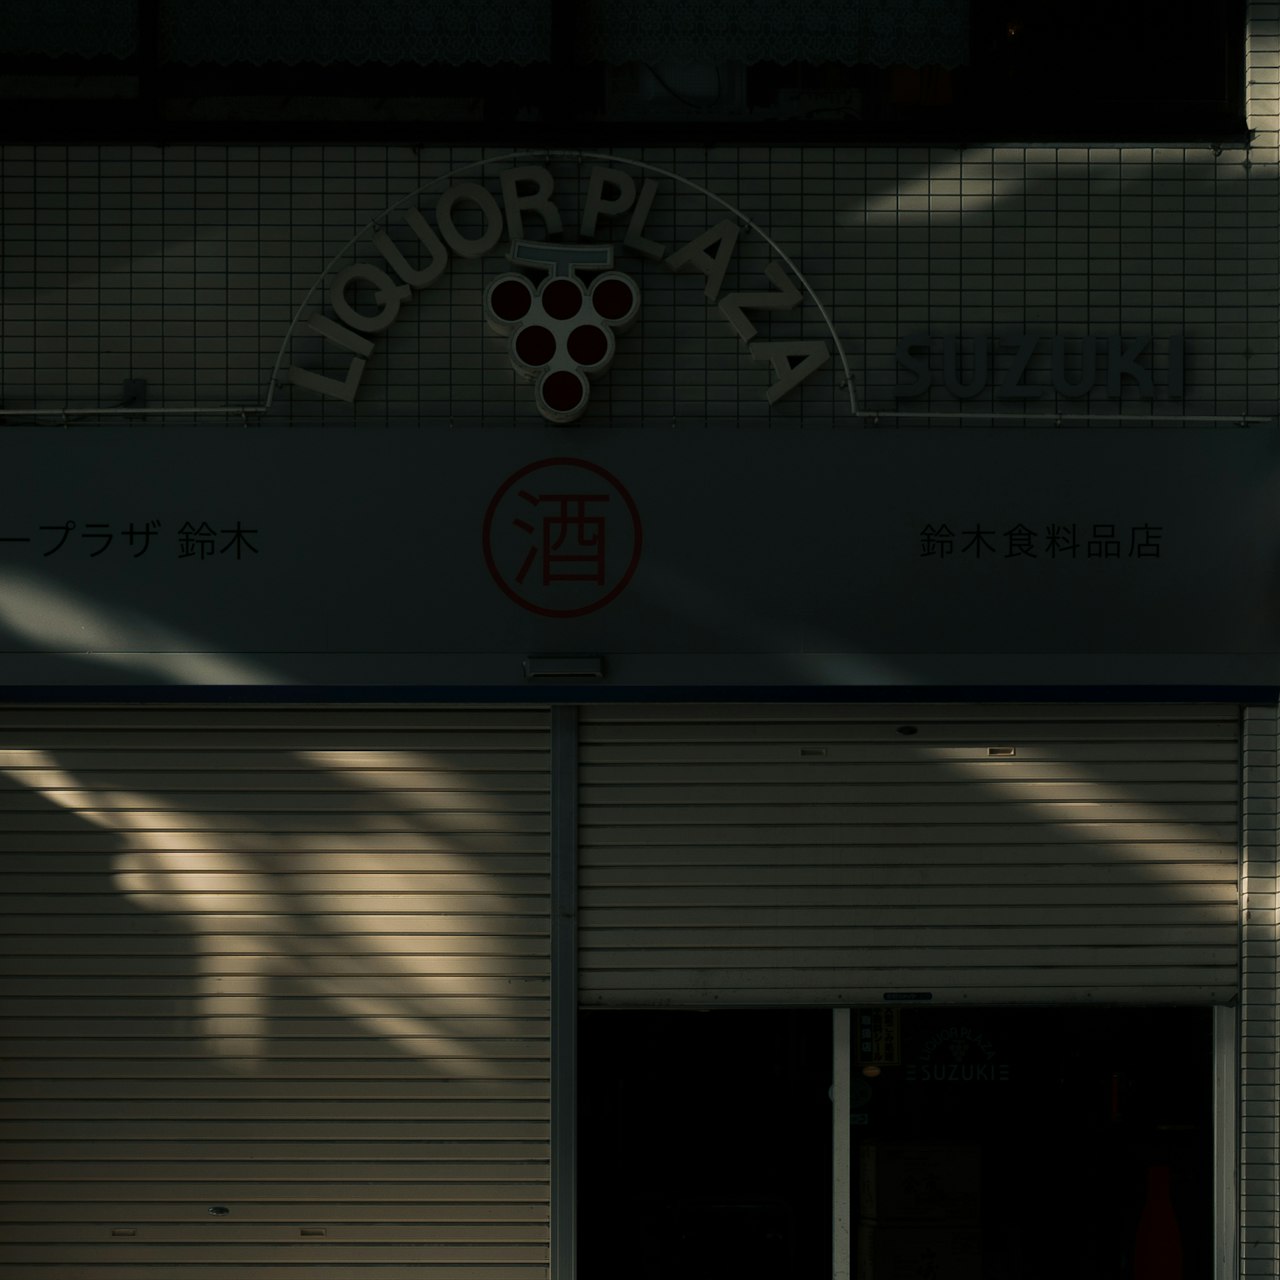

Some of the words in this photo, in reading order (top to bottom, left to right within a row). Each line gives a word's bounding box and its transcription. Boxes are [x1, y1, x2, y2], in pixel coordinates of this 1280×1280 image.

[287, 165, 564, 402] LIQUOR
[579, 165, 831, 405] PLAZA
[892, 333, 1186, 401] SUZUKI
[177, 521, 260, 560] 鈴木
[511, 492, 611, 588] 酒
[920, 523, 1163, 560] 鈴木食料品店
